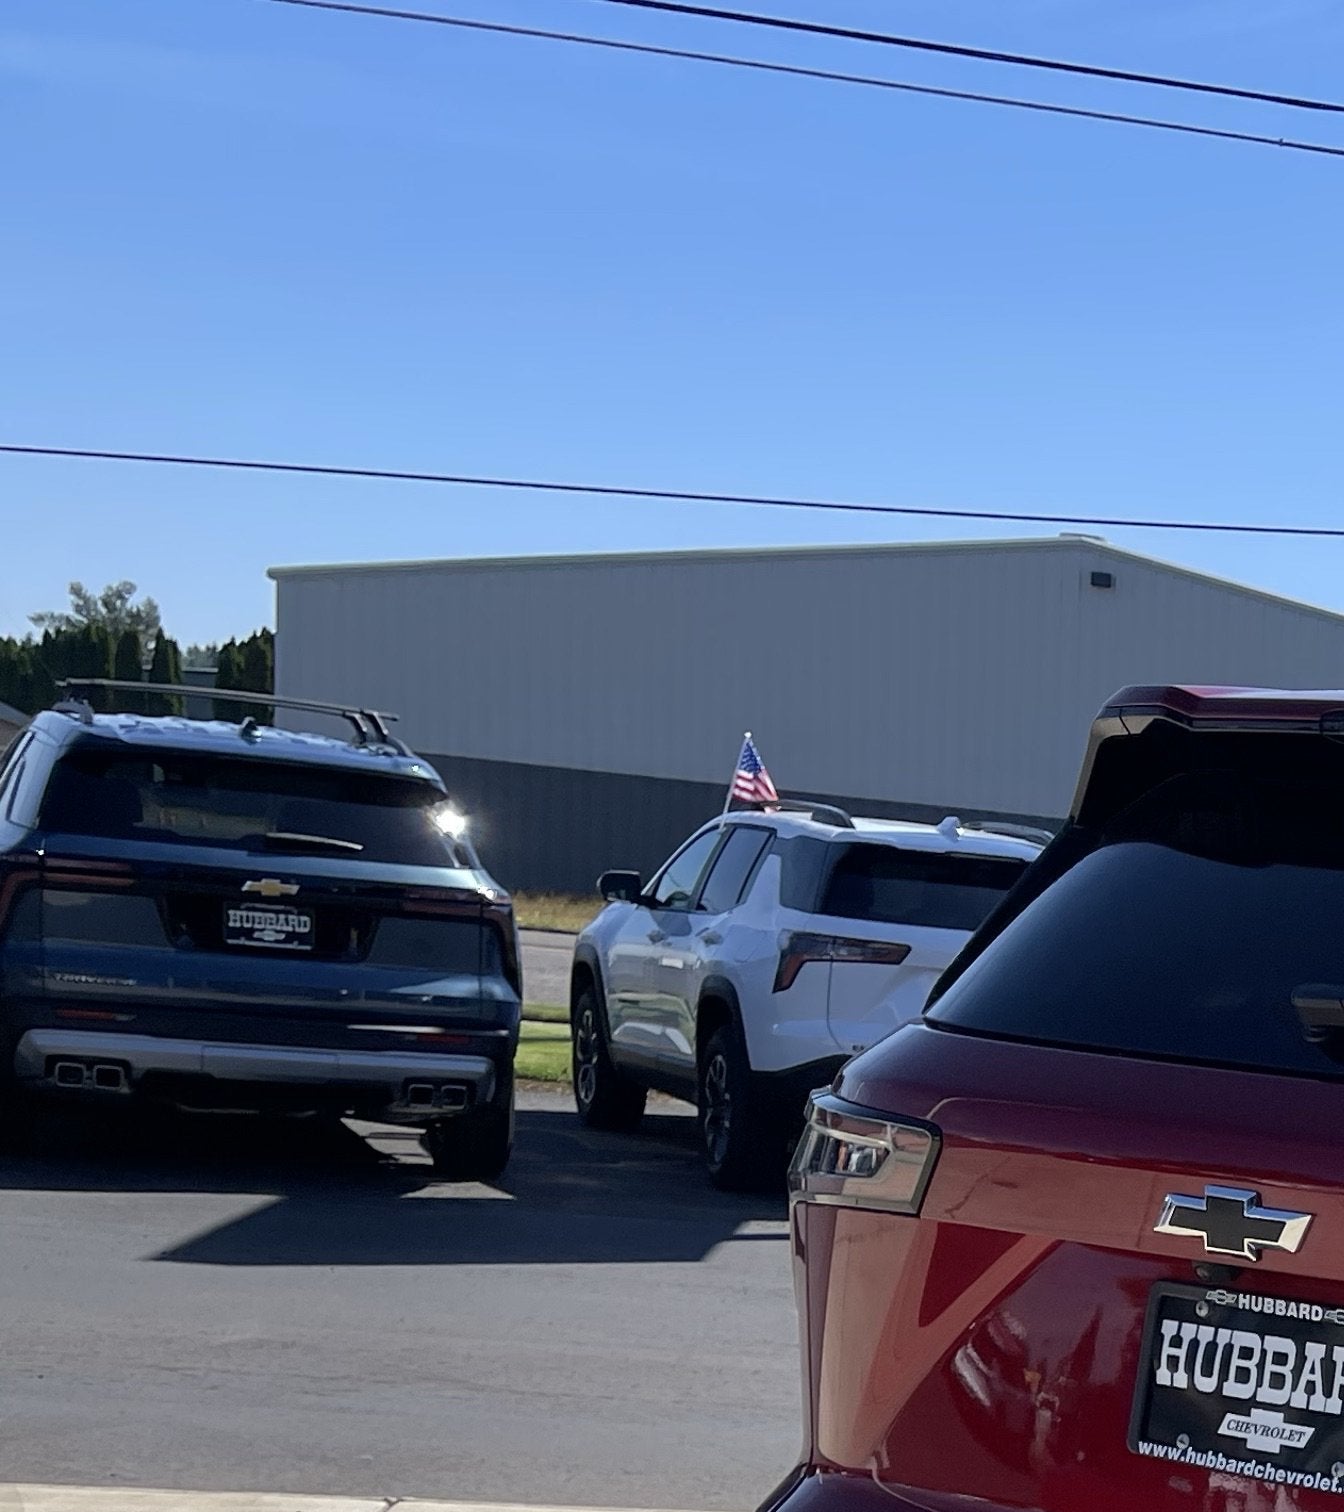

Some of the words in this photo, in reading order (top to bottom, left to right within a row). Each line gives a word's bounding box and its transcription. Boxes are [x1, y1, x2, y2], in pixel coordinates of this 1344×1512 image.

[228, 909, 311, 933] HUBBARD
[1238, 1293, 1323, 1320] HUBBARD
[1226, 1418, 1307, 1443] CHEVROLET
